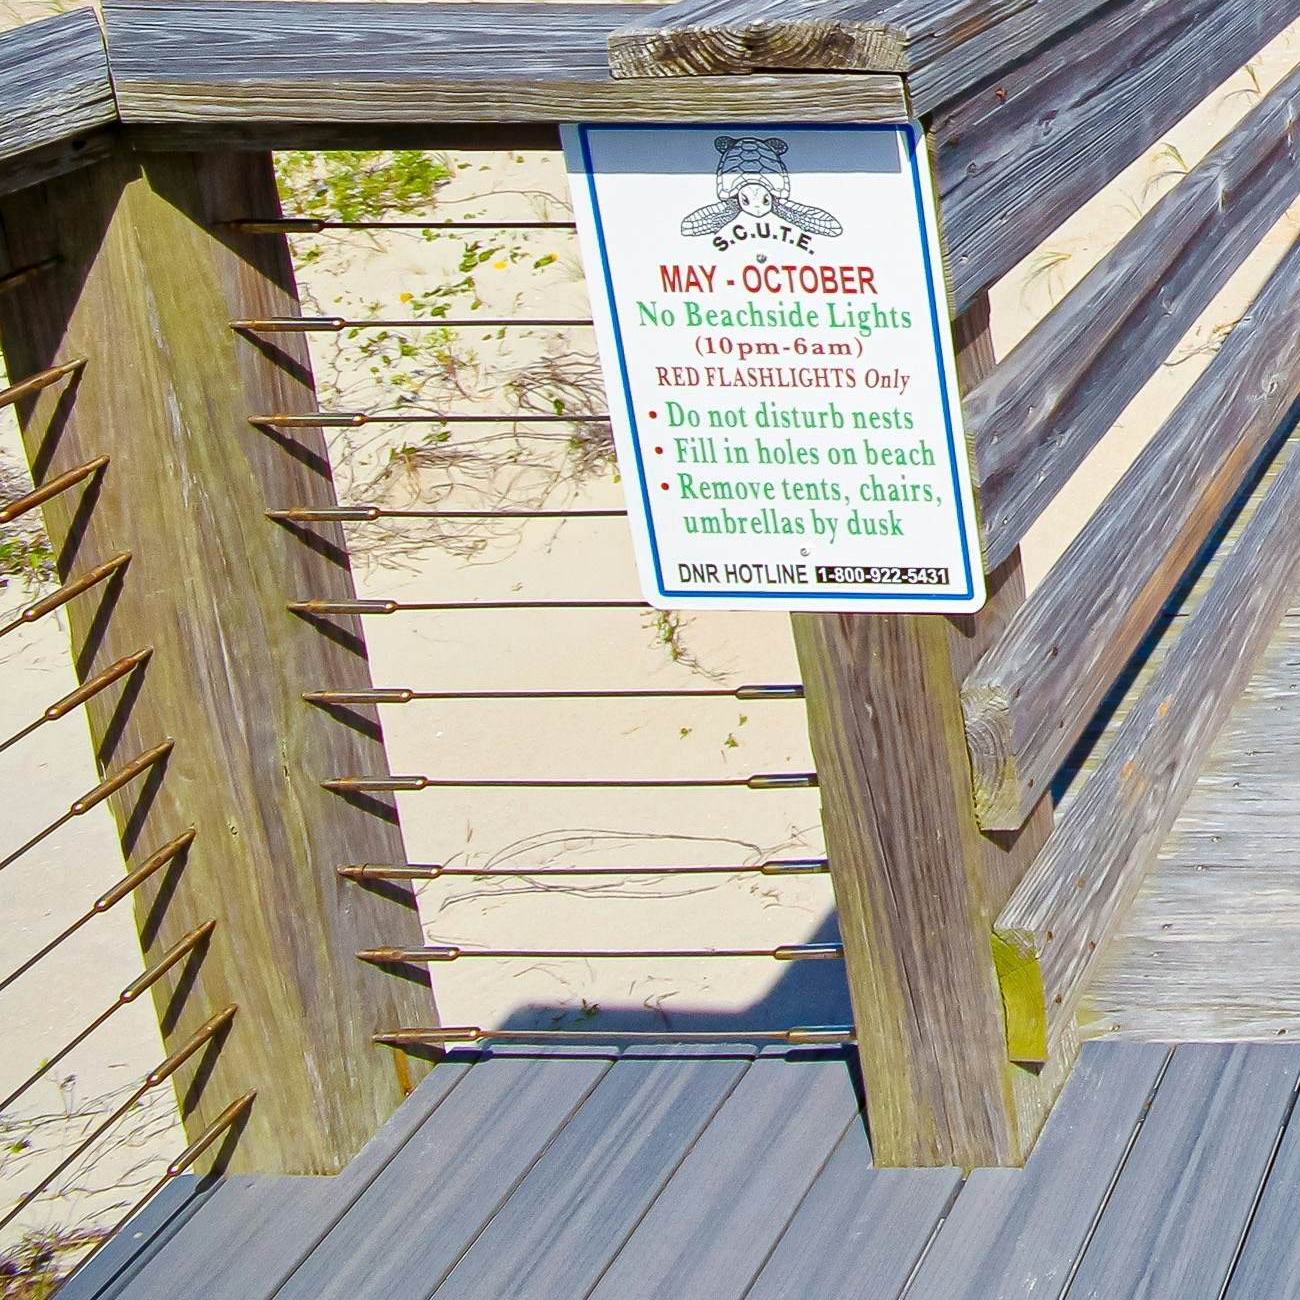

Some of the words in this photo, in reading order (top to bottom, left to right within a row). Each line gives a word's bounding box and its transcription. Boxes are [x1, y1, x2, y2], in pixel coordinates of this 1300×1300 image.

[712, 225, 815, 254] S.C.U.T.E.
[659, 265, 717, 293] MAY
[742, 265, 877, 294] OCTOBER
[636, 302, 675, 327] No
[686, 302, 819, 328] Beachside
[829, 303, 911, 337] Lights
[695, 337, 863, 360] (10pm-6am)
[658, 367, 700, 387] RED
[706, 367, 856, 389] FLASHLIGHTS
[865, 368, 909, 394] Only
[665, 402, 699, 428] Do
[709, 406, 746, 428] not
[755, 403, 844, 429] disturb
[853, 409, 913, 430] nests
[675, 438, 717, 464] Fill
[724, 440, 747, 464] in
[758, 439, 820, 465] holes
[828, 446, 856, 465] on
[866, 440, 936, 466] beach
[680, 474, 774, 500] Remove
[781, 478, 850, 504] tents,
[860, 475, 942, 506] chairs,
[683, 509, 805, 535] umbrellas
[814, 510, 838, 544] by
[847, 510, 904, 536] dusk
[678, 564, 719, 584] DNR
[725, 564, 808, 584] HOTLINE
[817, 567, 947, 584] 1-800-922-5431
